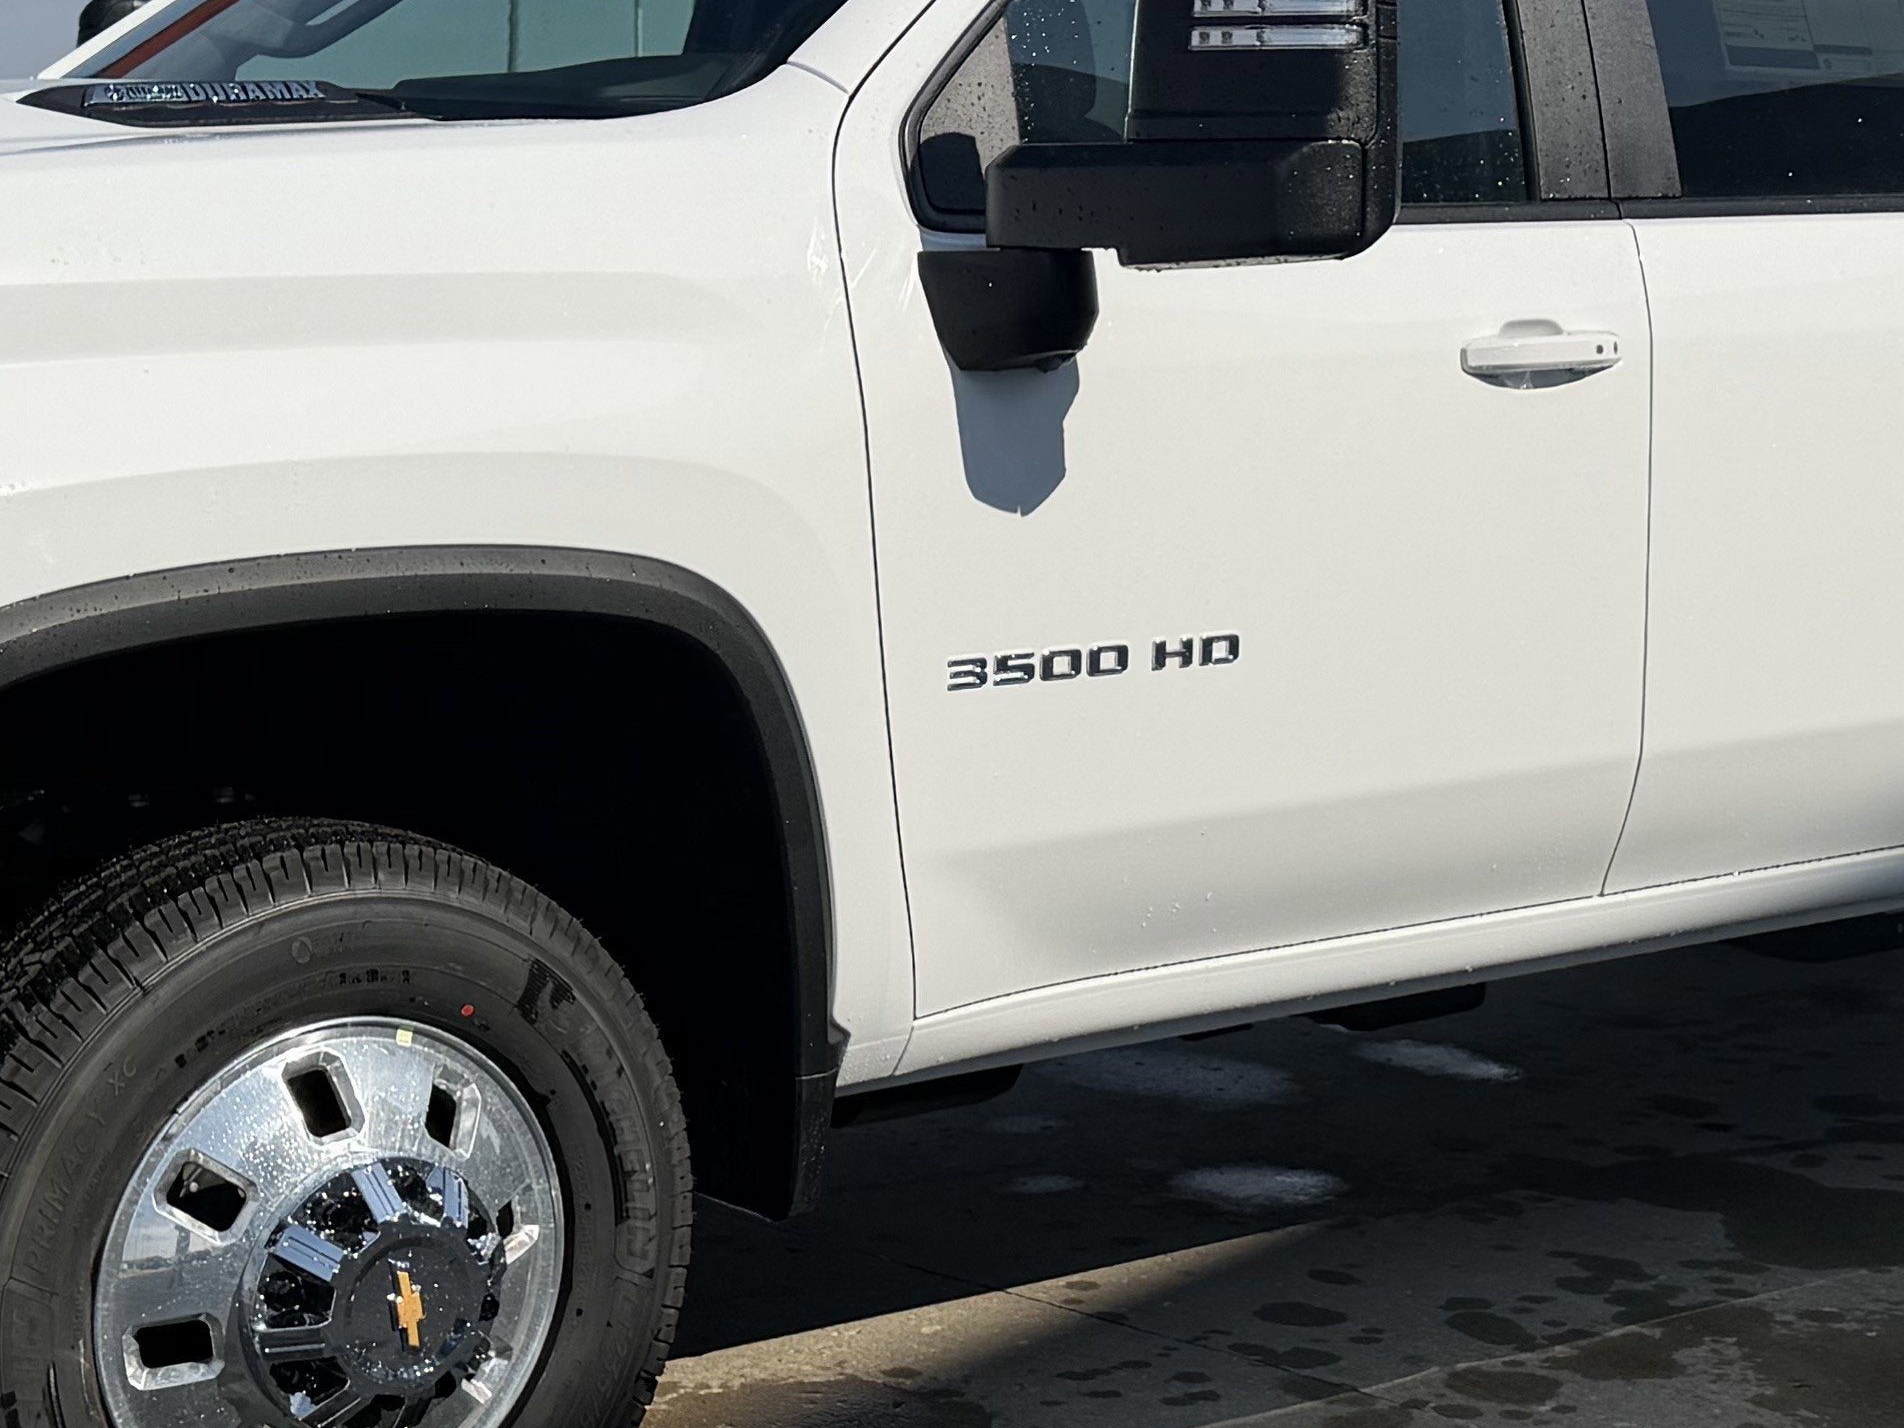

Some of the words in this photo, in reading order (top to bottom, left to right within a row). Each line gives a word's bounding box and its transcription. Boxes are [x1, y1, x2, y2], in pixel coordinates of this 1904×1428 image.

[183, 80, 326, 102] DURAMAX
[946, 644, 1129, 692] 3500
[1151, 633, 1240, 672] HD
